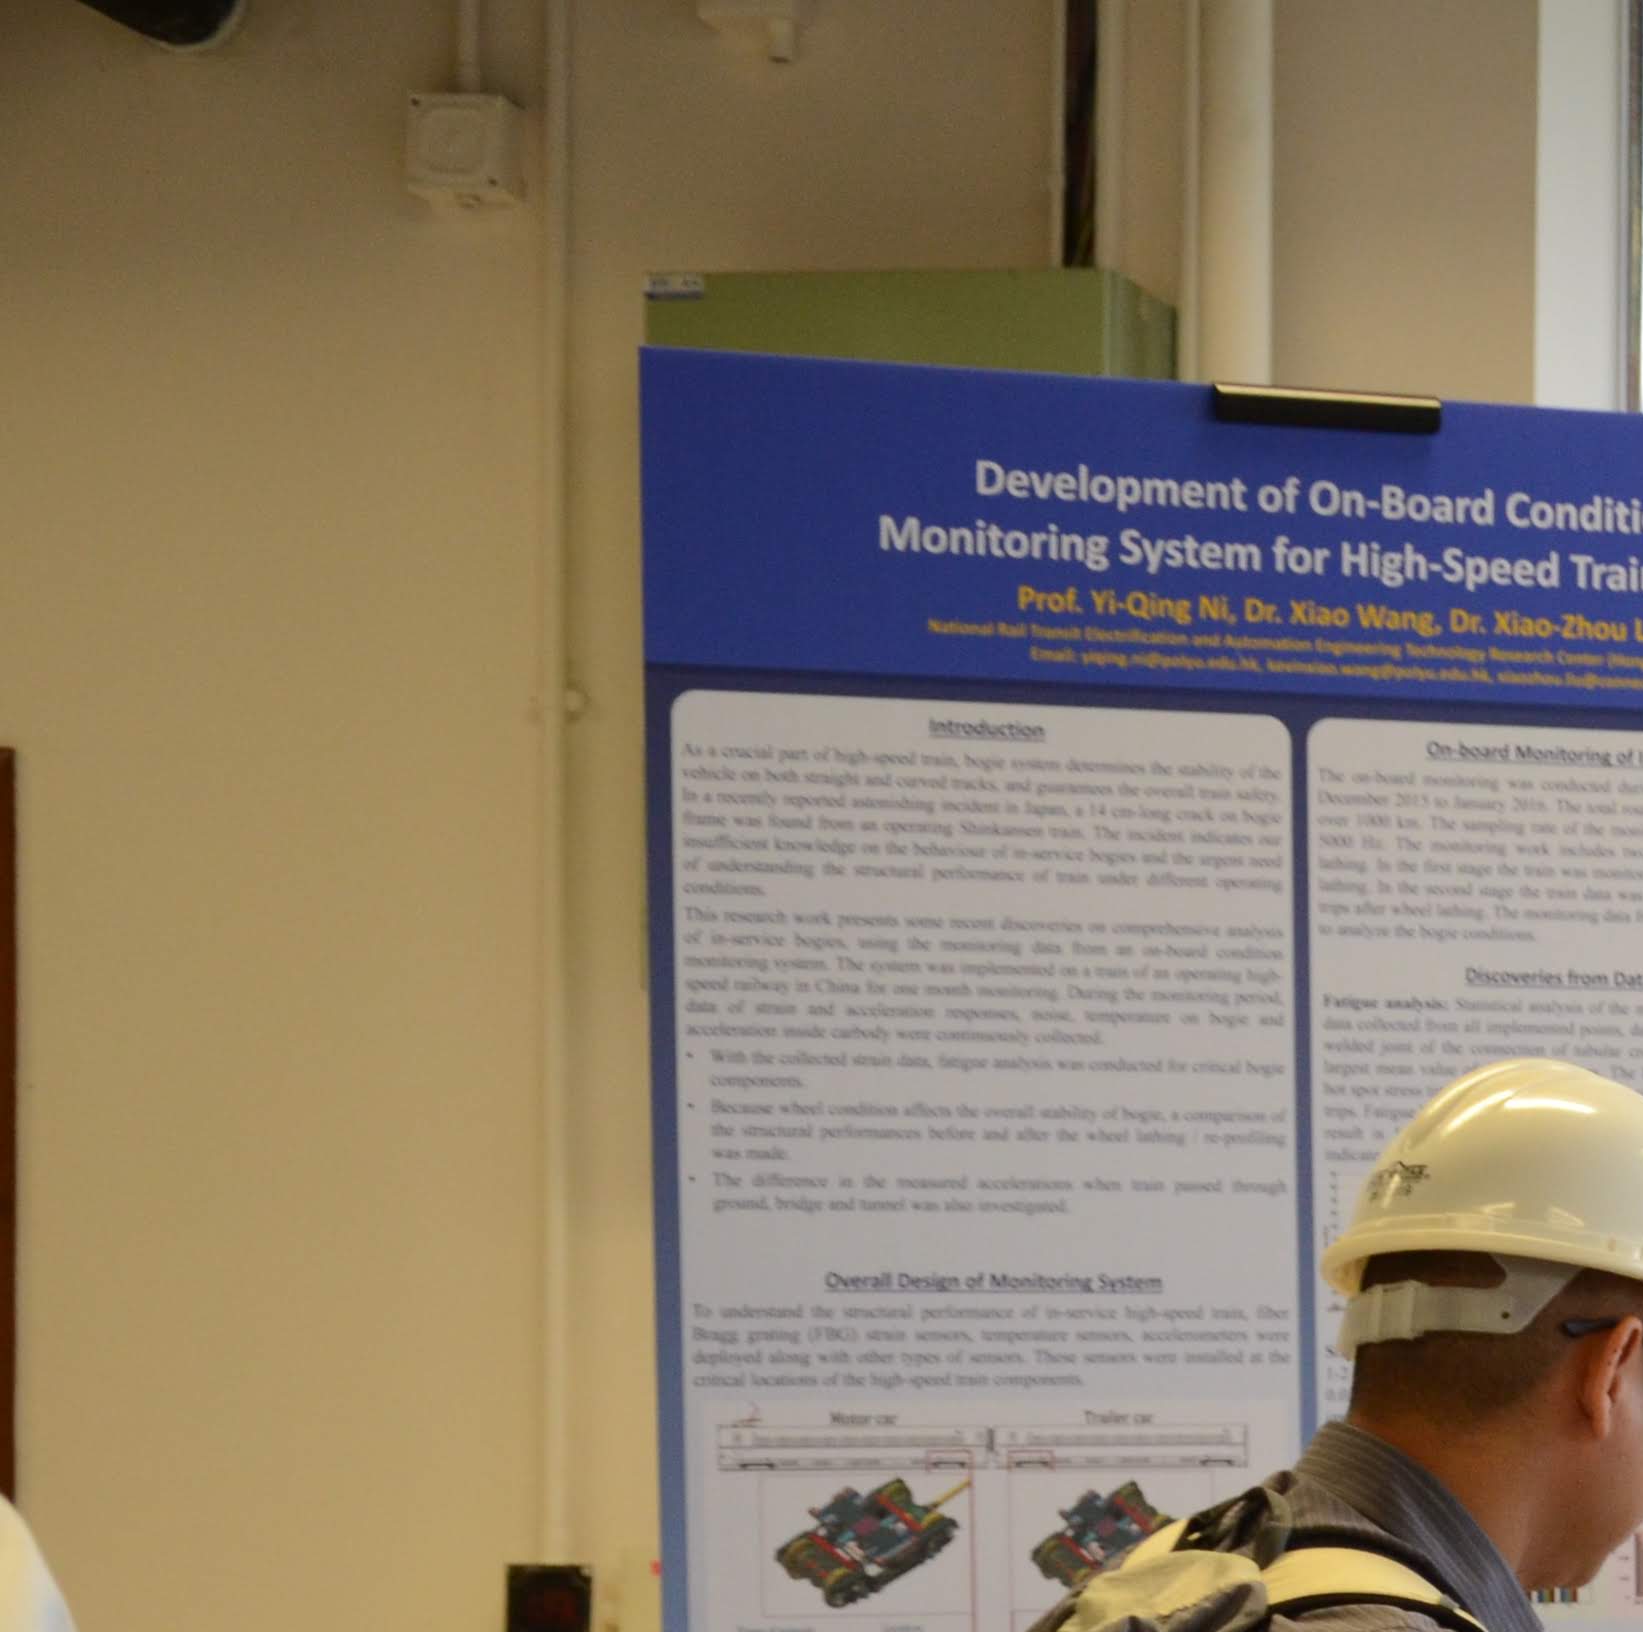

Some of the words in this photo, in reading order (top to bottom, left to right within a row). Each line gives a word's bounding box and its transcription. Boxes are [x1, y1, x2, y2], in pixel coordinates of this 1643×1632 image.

[976, 462, 1246, 512] Development
[1258, 476, 1298, 513] of
[1309, 481, 1495, 523] On-Board
[879, 517, 1108, 570] Monitoring
[1120, 528, 1261, 573] System
[1273, 535, 1328, 572] for
[1340, 539, 1560, 589] High-Speed
[1017, 583, 1080, 612] Prof.
[1092, 587, 1192, 623] Yi-Qing
[1198, 593, 1234, 622] Ni,
[1243, 595, 1280, 623] Dr.
[1290, 597, 1350, 626] Xiao
[1356, 601, 1438, 635] Wang,
[1449, 605, 1484, 633] Dr.
[1494, 607, 1627, 640] Xiao-Zhou
[928, 719, 1044, 737] Introduction
[1426, 742, 1510, 760] On-board
[1514, 745, 1611, 767] Monitoring
[1616, 749, 1633, 764] of
[1464, 967, 1562, 985] Discoveries
[1567, 970, 1608, 986] from
[825, 1272, 893, 1287] Overall
[897, 1272, 960, 1292] Design
[965, 1273, 984, 1288] of
[989, 1273, 1092, 1293] Monitoring
[1098, 1274, 1162, 1293] System
